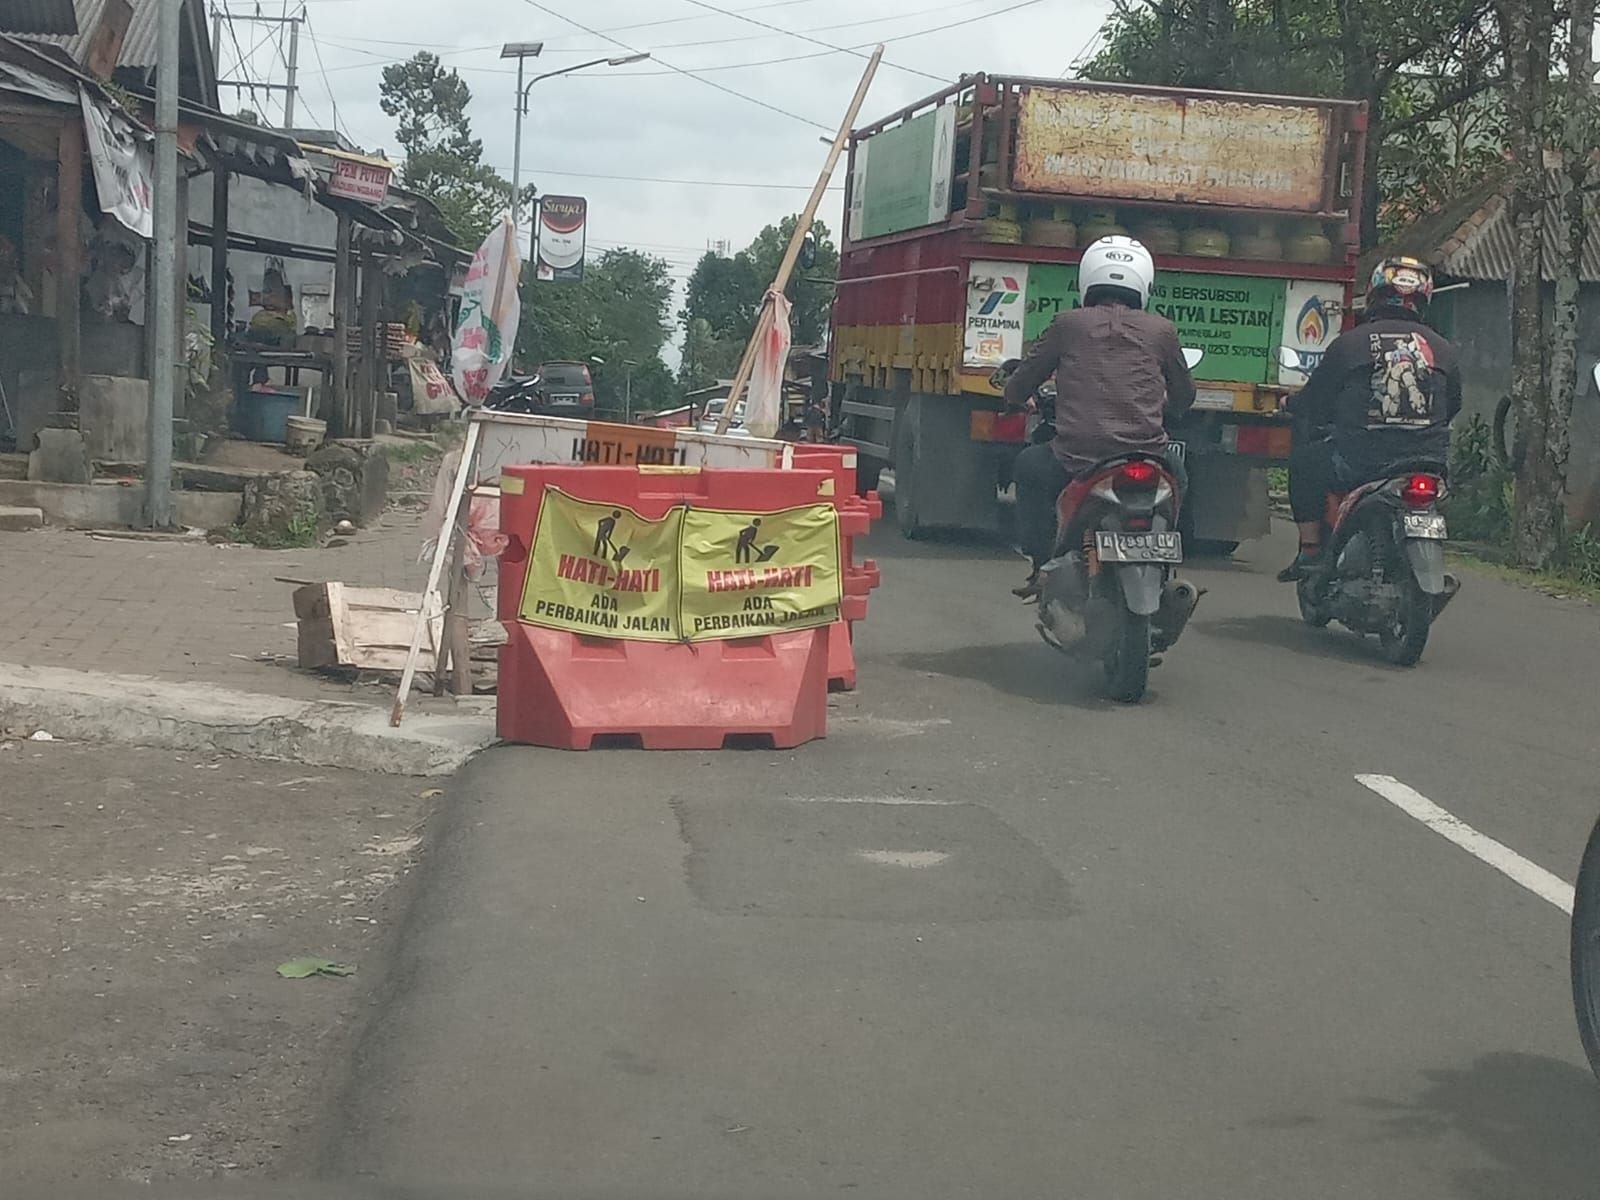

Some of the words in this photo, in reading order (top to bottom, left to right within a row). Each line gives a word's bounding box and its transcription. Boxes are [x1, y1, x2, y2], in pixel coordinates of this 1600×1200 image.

[360, 165, 390, 186] PUTIH
[542, 199, 584, 216] Surya
[1172, 286, 1250, 304] BERSUBSIDI
[968, 316, 1020, 330] PERTAMINA
[1038, 298, 1064, 313] PT
[1155, 303, 1205, 323] SATYA
[1209, 307, 1272, 328] LESTARI
[572, 438, 686, 465] HATI-HATI
[557, 554, 659, 592] HATI-HATI
[707, 565, 812, 593] HATI-HATI
[590, 594, 618, 611] ADA
[742, 596, 773, 611] ADA
[535, 600, 618, 629] PERBAIKAN
[623, 616, 670, 632] JALAN
[694, 611, 775, 632] PERBAIKAN
